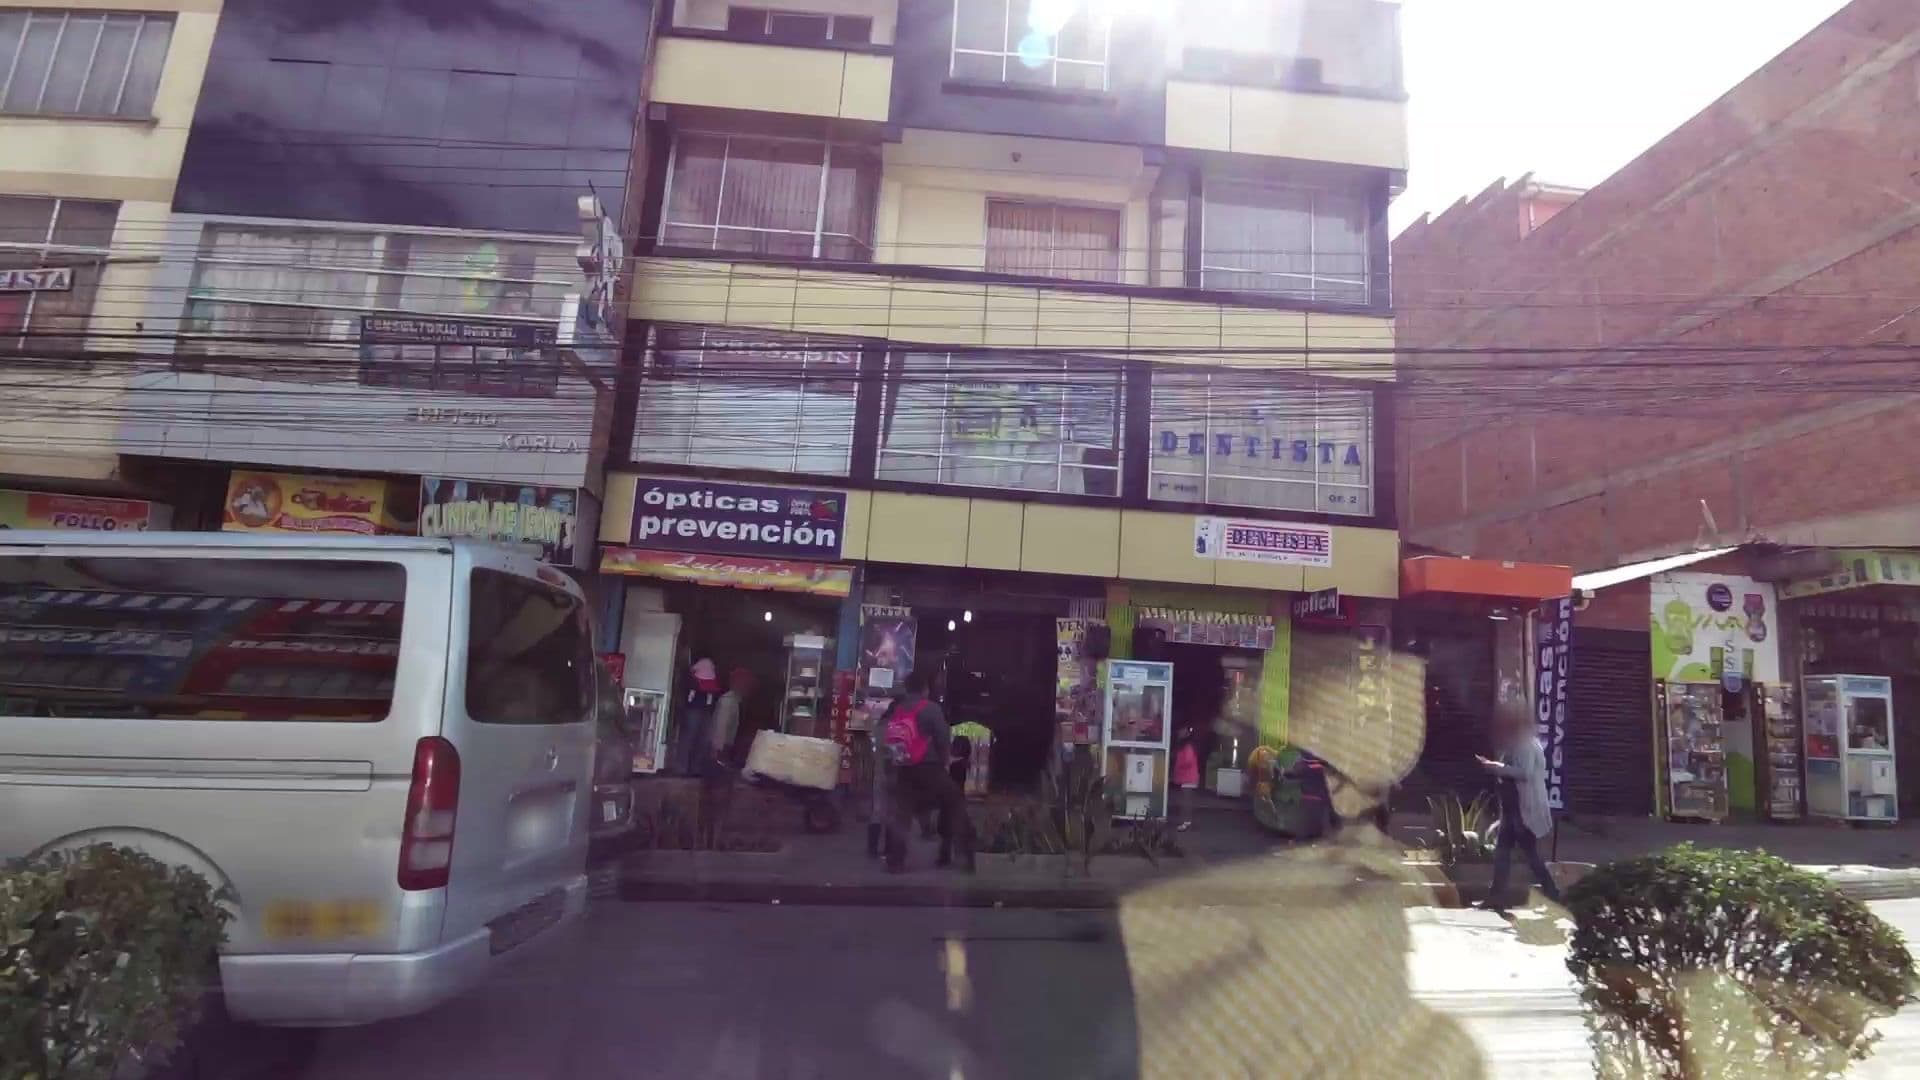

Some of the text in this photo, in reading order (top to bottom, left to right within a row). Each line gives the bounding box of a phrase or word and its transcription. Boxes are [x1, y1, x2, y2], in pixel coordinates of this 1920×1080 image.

[1160, 430, 1361, 466] DENTISTA
[643, 487, 779, 513] ópticas
[639, 514, 835, 547] prevención
[1232, 527, 1324, 551] DENTISTA
[1548, 597, 1571, 809] prevención
